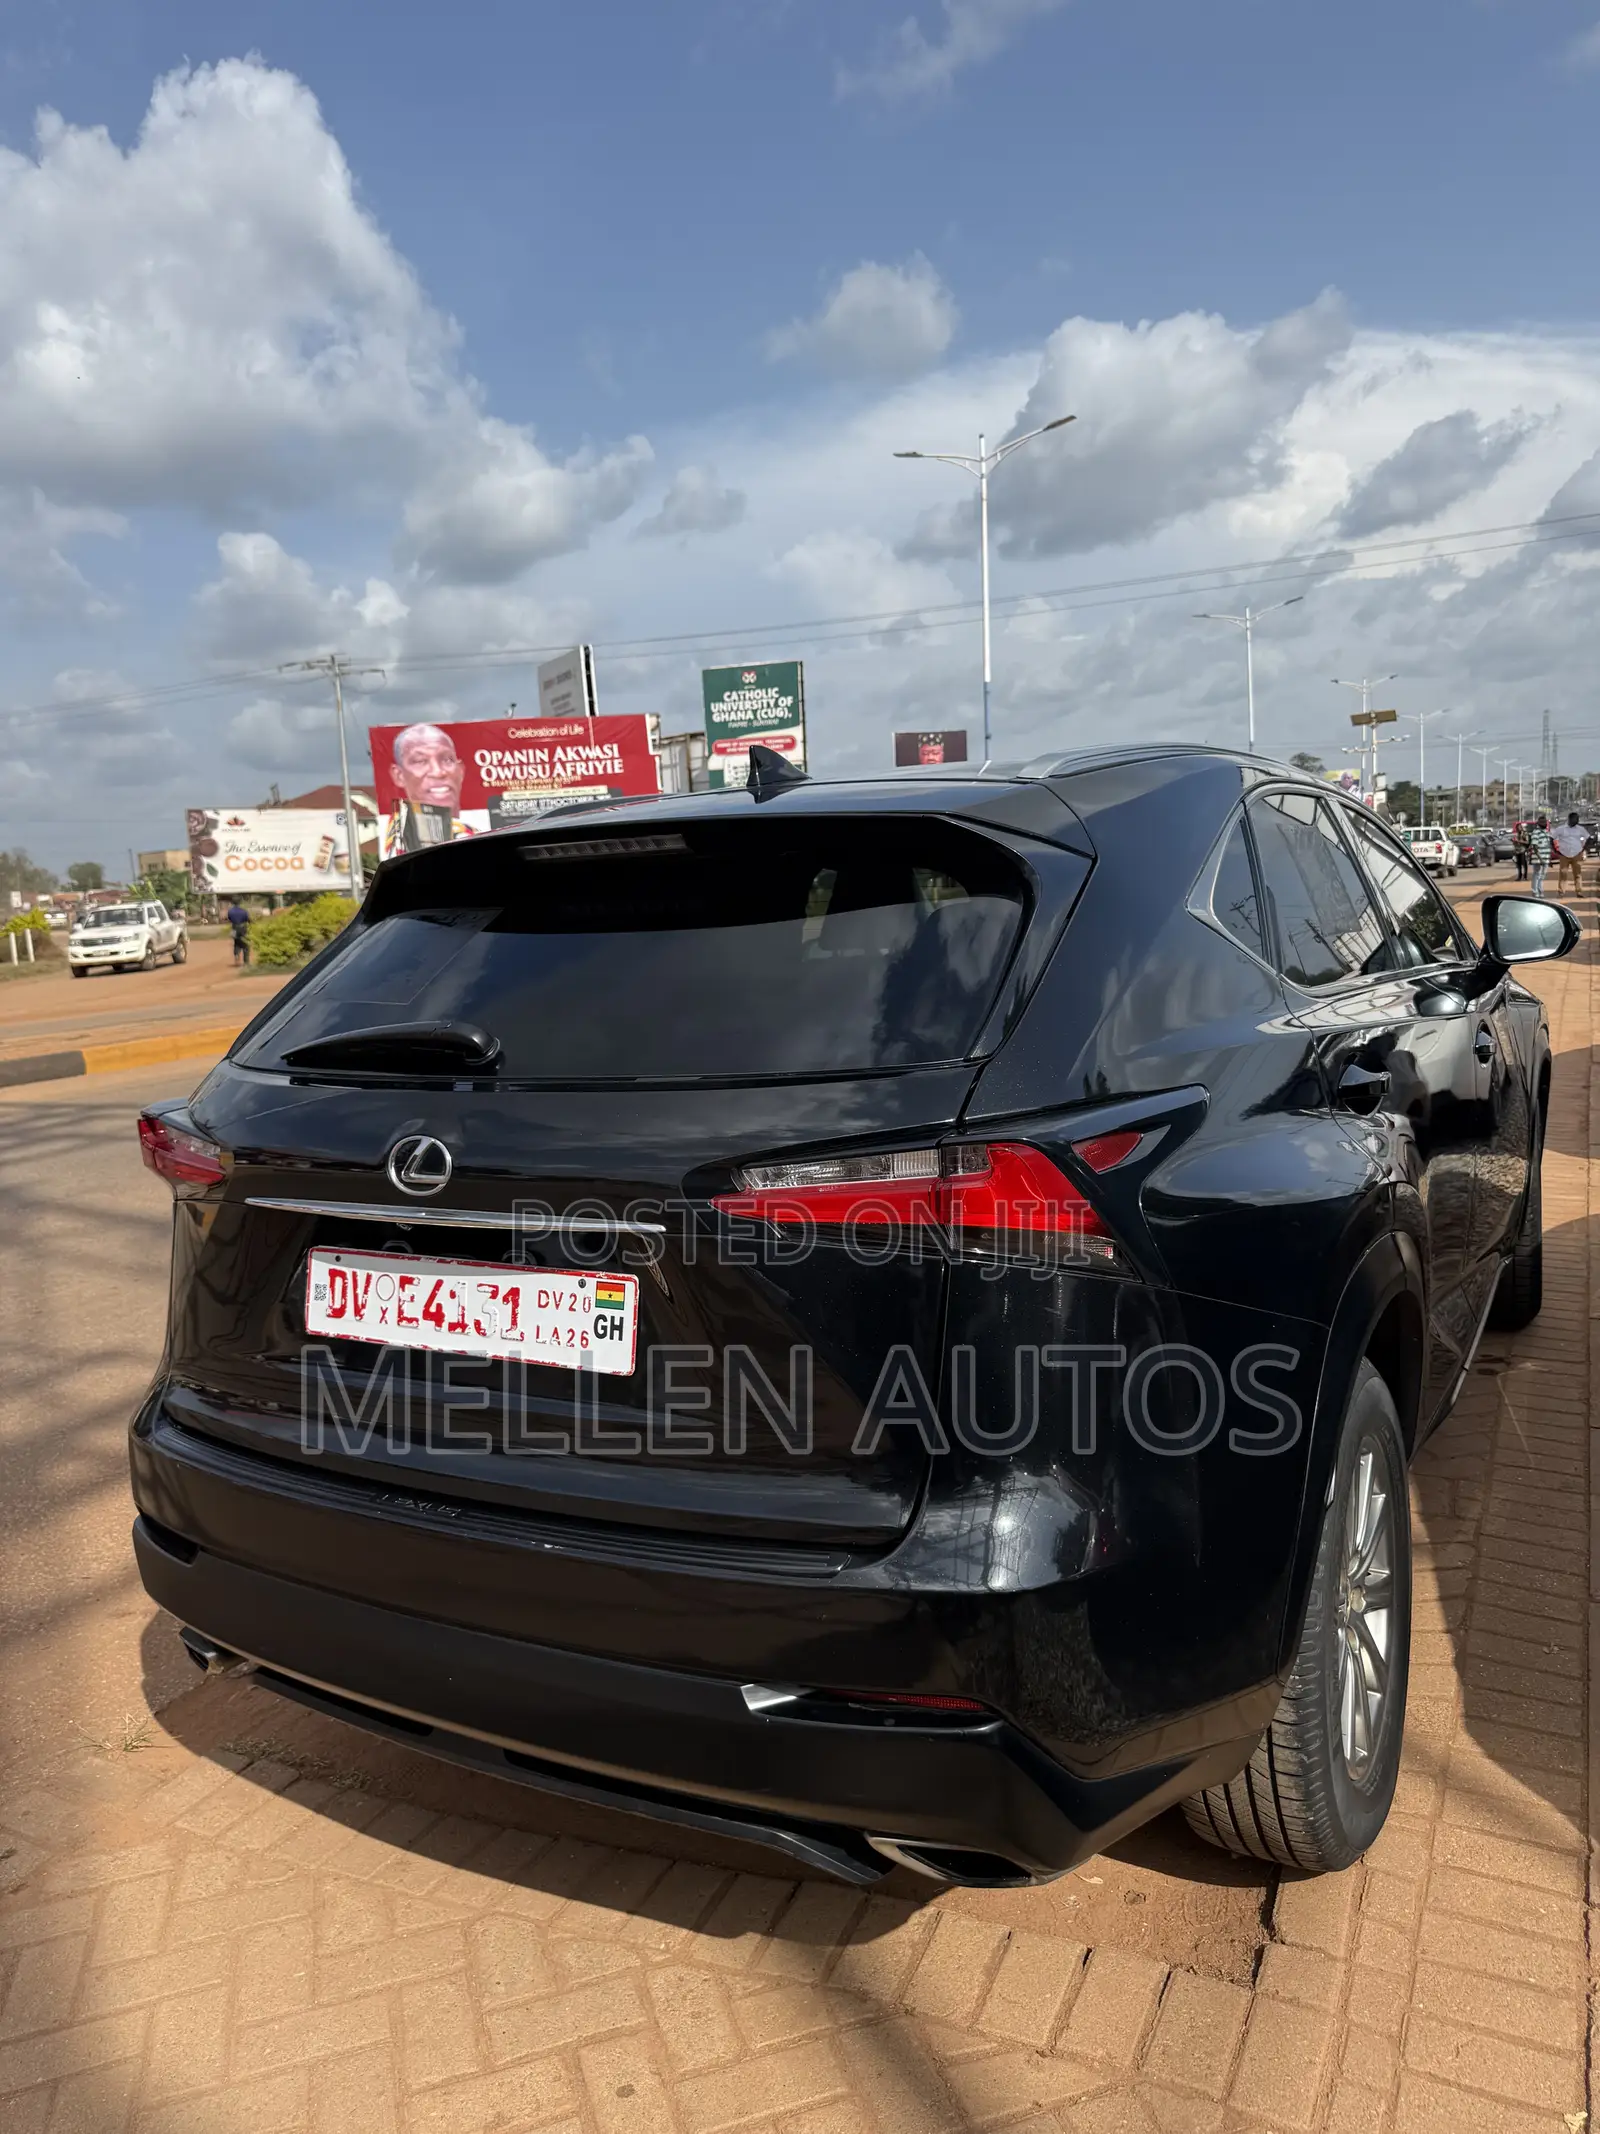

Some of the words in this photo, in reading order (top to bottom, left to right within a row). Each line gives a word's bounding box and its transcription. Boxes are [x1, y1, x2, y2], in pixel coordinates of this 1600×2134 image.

[723, 687, 779, 702] CATHOLIC
[710, 698, 776, 713] UNIVERSITY
[778, 696, 793, 707] OF
[712, 709, 754, 723] GHANA
[507, 725, 557, 739] Celebration
[559, 725, 569, 737] of
[569, 723, 584, 736] Life
[474, 748, 549, 767] OPANIN
[553, 743, 620, 764] AKWASI
[480, 763, 550, 782] OWUSU
[553, 758, 624, 779] AFRIYIE
[224, 840, 244, 853] The
[247, 840, 290, 854] Essence
[291, 842, 302, 856] of
[224, 855, 305, 872] Cocoa
[326, 1267, 373, 1321] DV
[397, 1274, 524, 1342] E4131
[593, 1313, 624, 1342] GH
